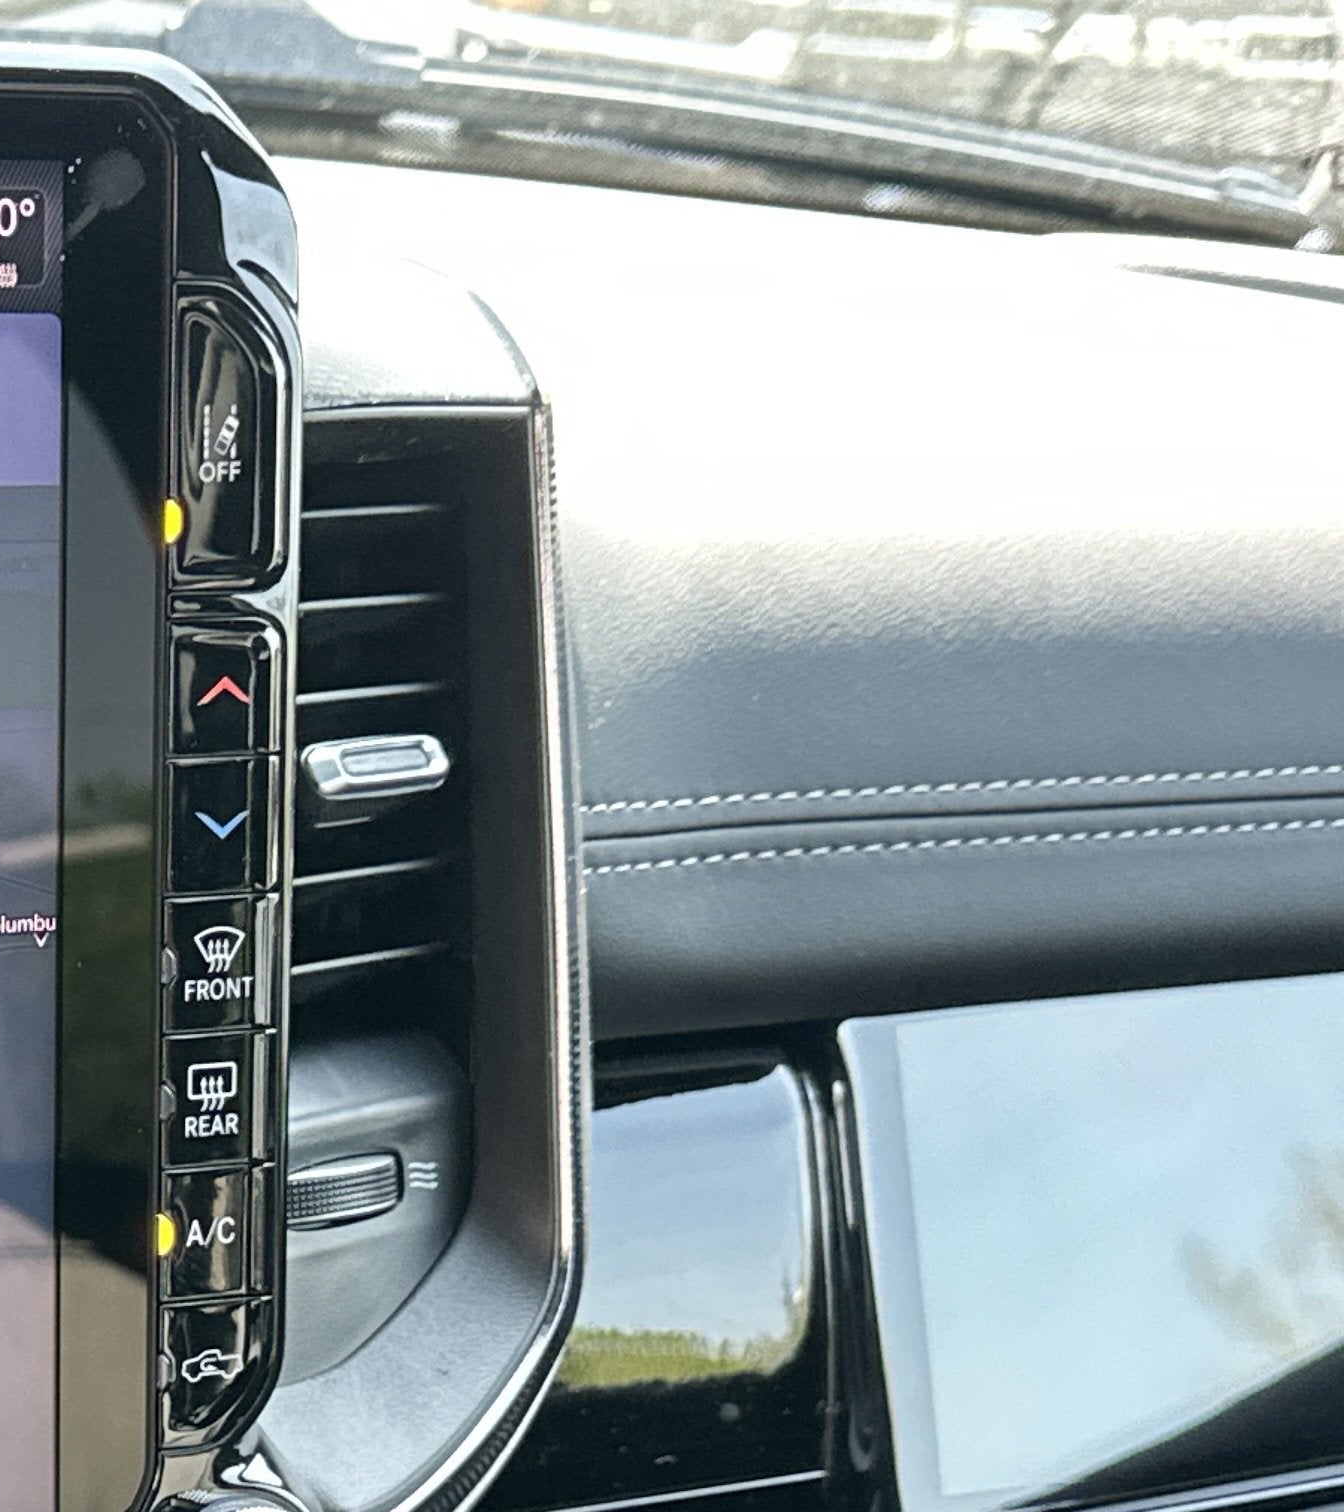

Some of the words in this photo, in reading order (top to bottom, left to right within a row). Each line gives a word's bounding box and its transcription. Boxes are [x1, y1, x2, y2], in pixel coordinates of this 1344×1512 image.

[199, 460, 242, 484] OFF
[184, 975, 255, 1002] FRONT
[184, 1113, 239, 1137] REAR
[186, 1216, 236, 1246] A/C
